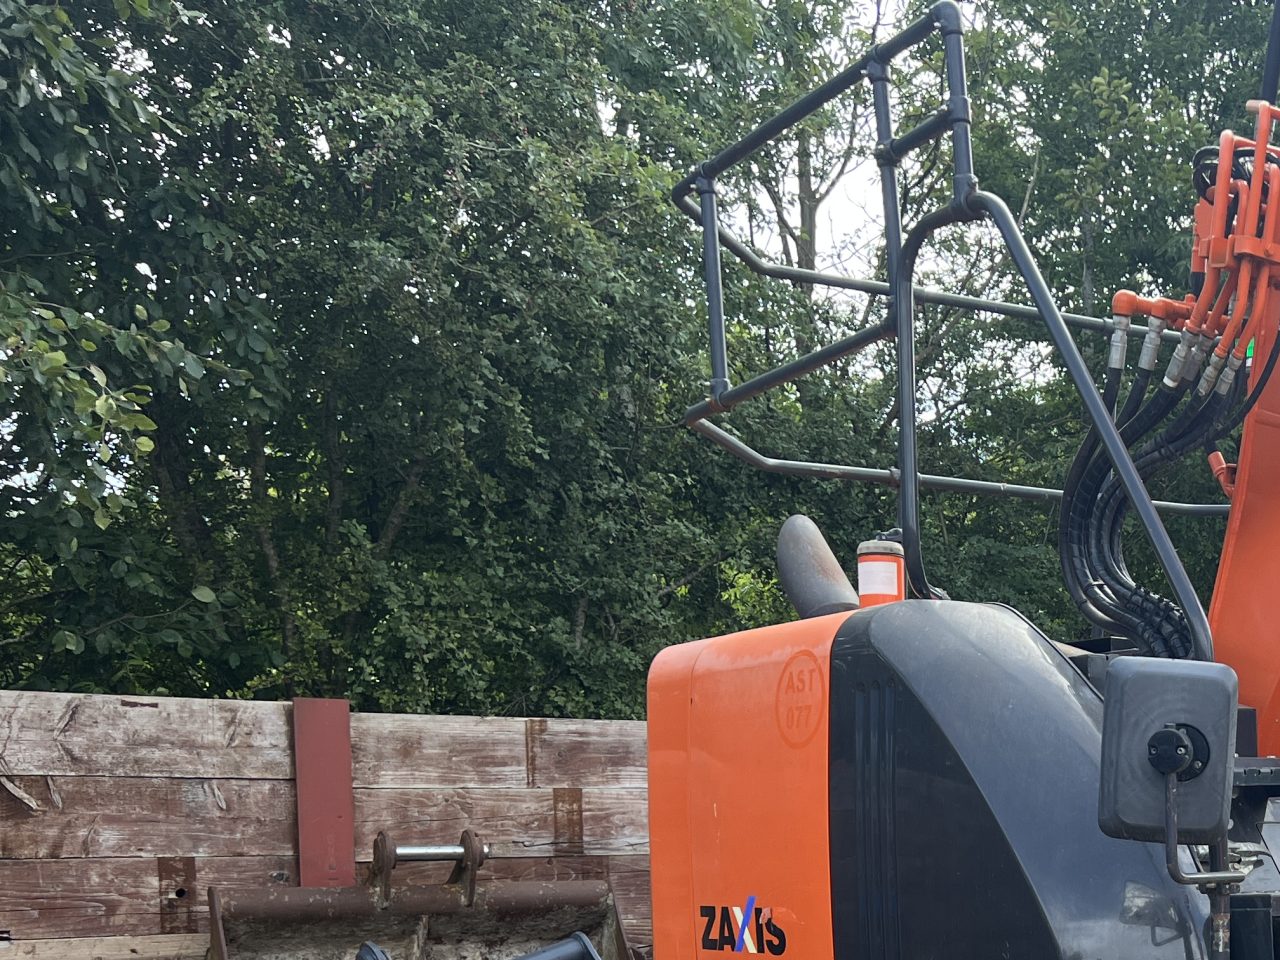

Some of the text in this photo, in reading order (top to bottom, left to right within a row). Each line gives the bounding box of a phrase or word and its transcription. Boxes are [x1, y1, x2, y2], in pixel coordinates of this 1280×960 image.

[785, 668, 816, 694] AST
[786, 704, 812, 729] 077
[700, 896, 787, 956] ZAXIS
